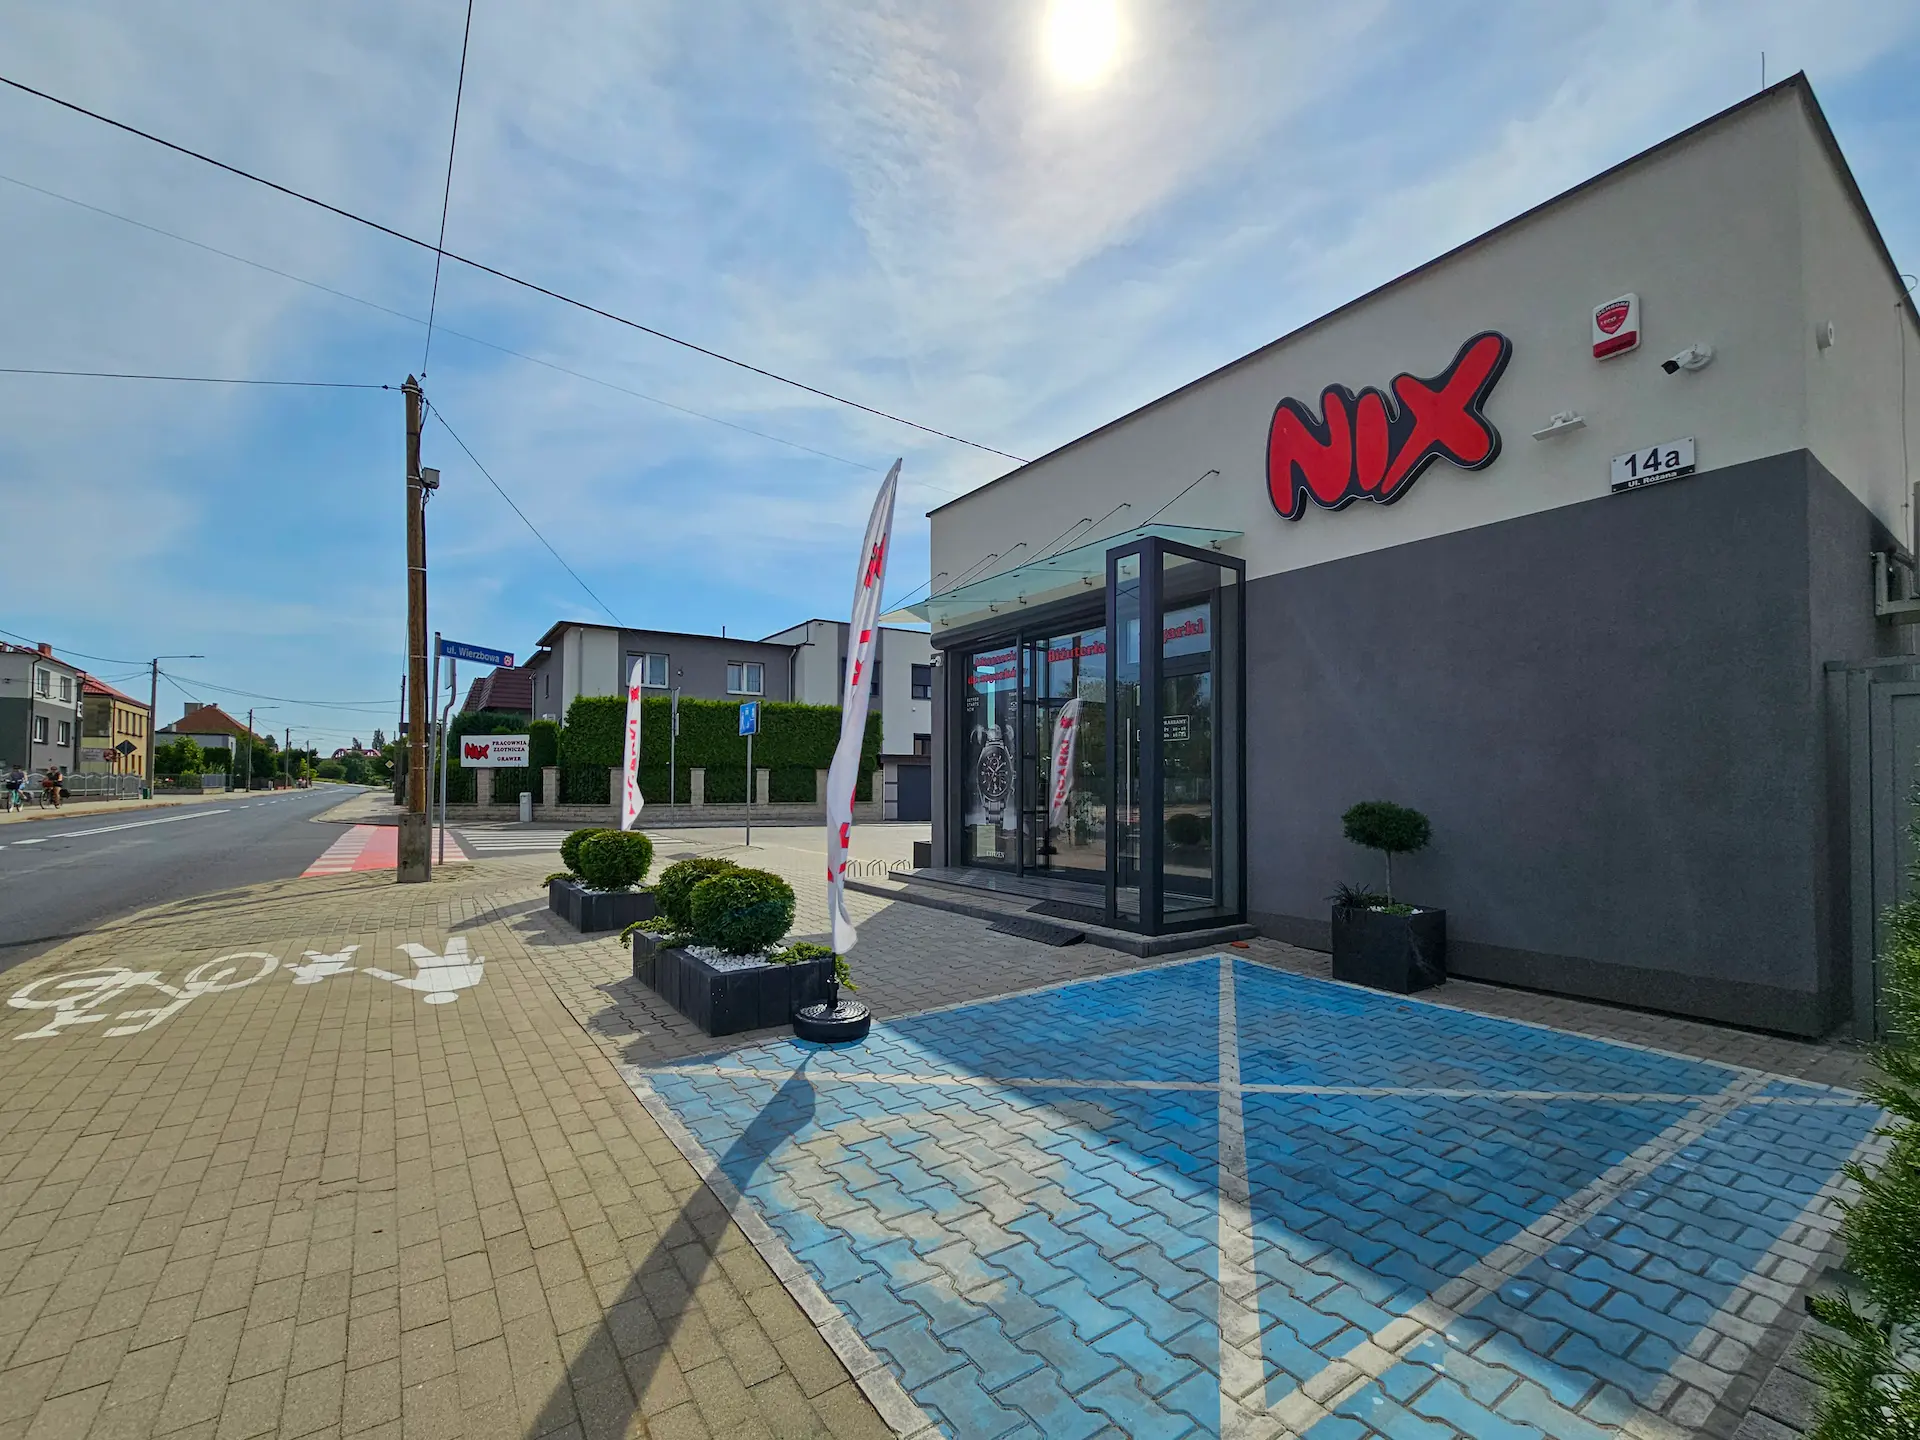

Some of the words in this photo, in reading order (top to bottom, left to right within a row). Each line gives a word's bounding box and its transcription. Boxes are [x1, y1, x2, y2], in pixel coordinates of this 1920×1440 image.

[1267, 332, 1508, 518] NIX
[1624, 447, 1681, 478] 14a
[1628, 480, 1641, 488] Ul.
[1643, 471, 1677, 484] Różana
[446, 645, 457, 655] ul.
[459, 647, 500, 663] Wierzbowa
[465, 742, 490, 760] NIX
